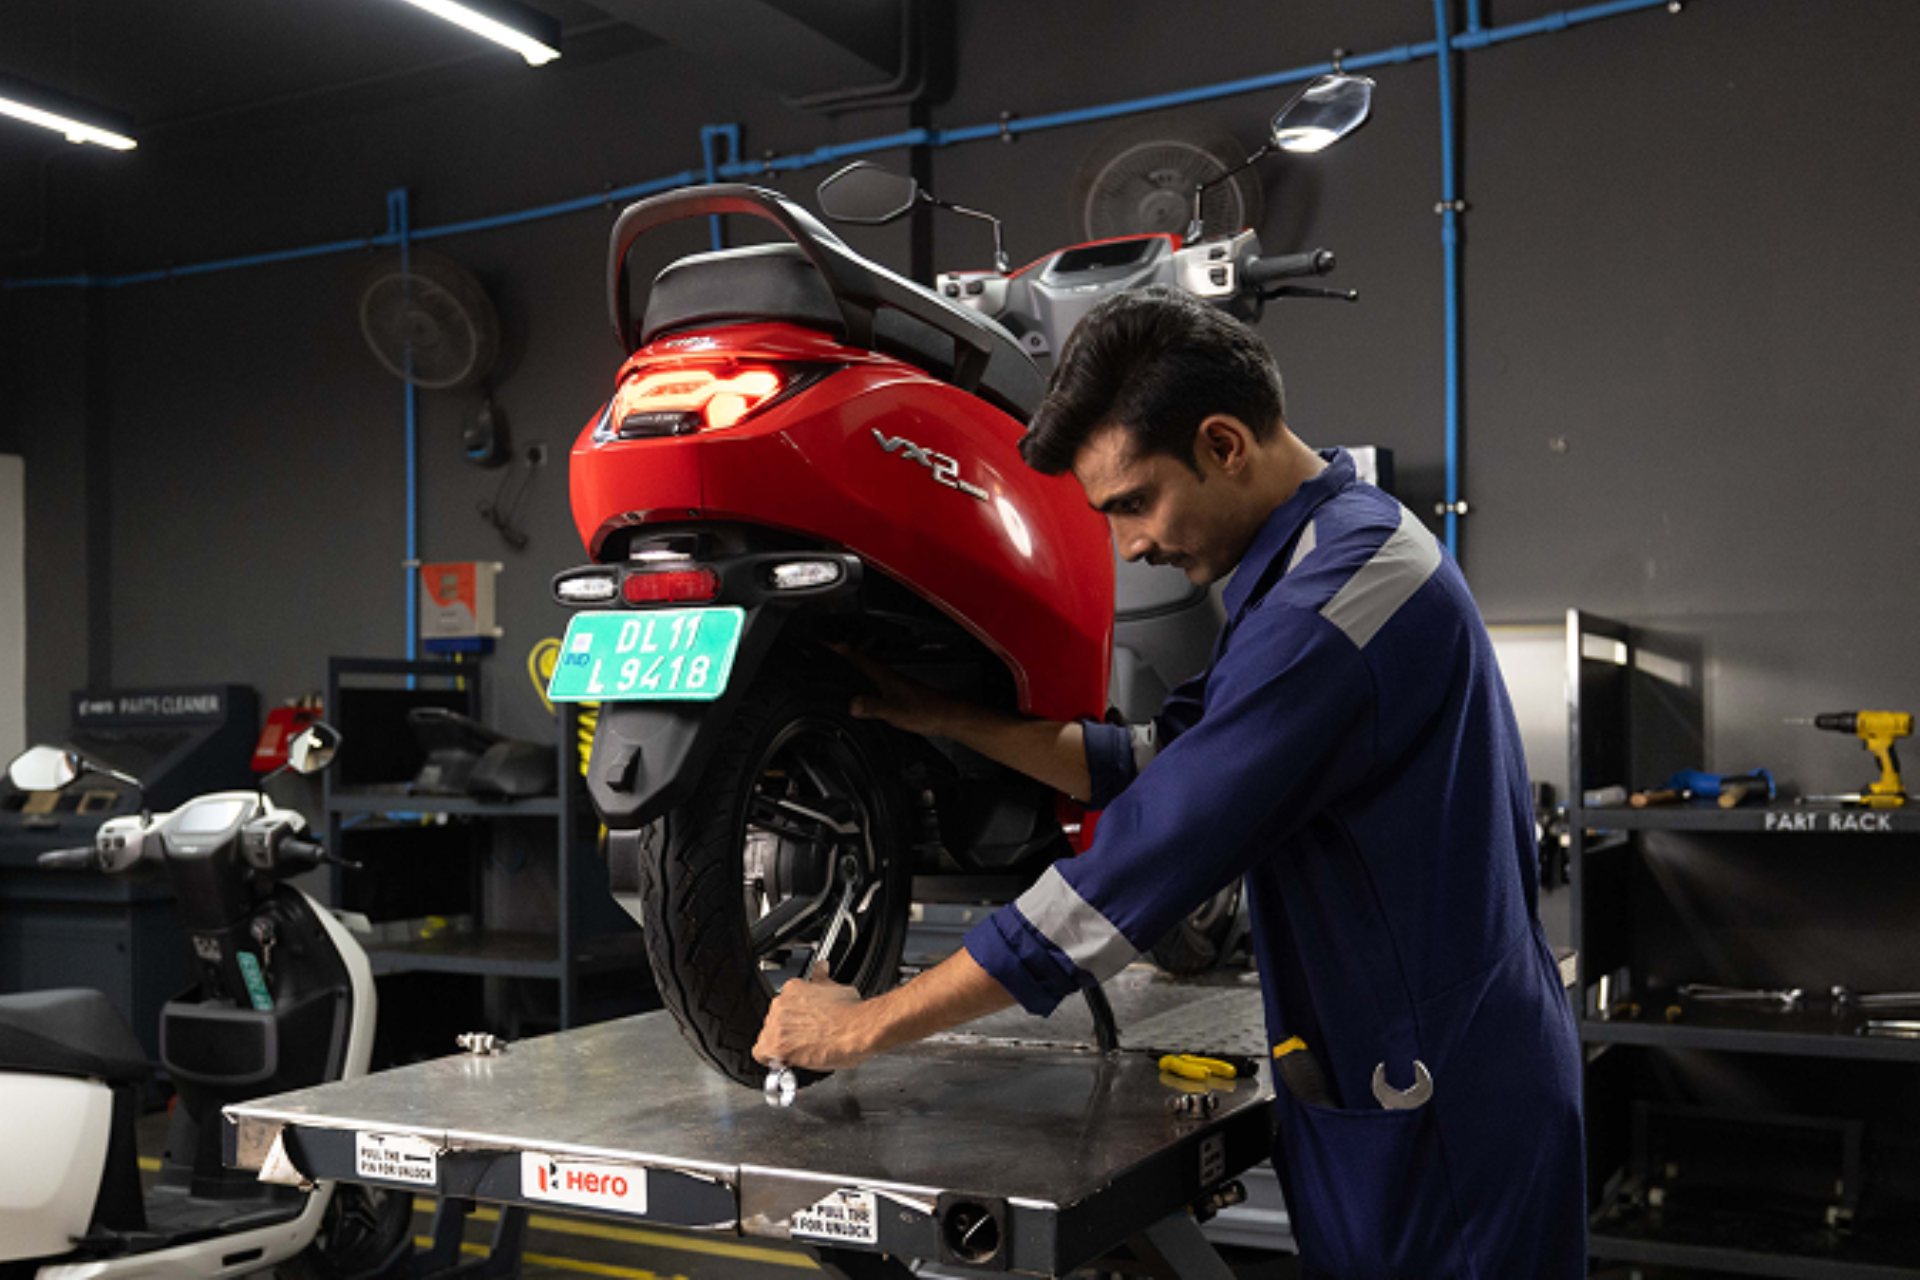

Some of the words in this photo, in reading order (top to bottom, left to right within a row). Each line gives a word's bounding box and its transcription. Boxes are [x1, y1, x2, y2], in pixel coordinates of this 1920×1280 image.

[871, 427, 959, 489] VX2
[615, 618, 659, 654] DL
[669, 615, 702, 651] 11
[586, 658, 605, 694] L
[617, 655, 711, 691] 9418
[119, 696, 159, 715] PARTS
[162, 694, 220, 714] CLEANER
[1765, 812, 1817, 831] PART
[1828, 812, 1892, 832] RACK
[361, 1146, 382, 1161] PULL
[384, 1148, 400, 1163] THE
[378, 1162, 397, 1175] FOR
[398, 1165, 433, 1180] UNLOCK
[566, 1170, 628, 1198] Hero
[817, 1205, 844, 1219] PULL
[848, 1208, 870, 1223] THE
[800, 1217, 824, 1232] FOR
[826, 1222, 871, 1238] UNLOCK
